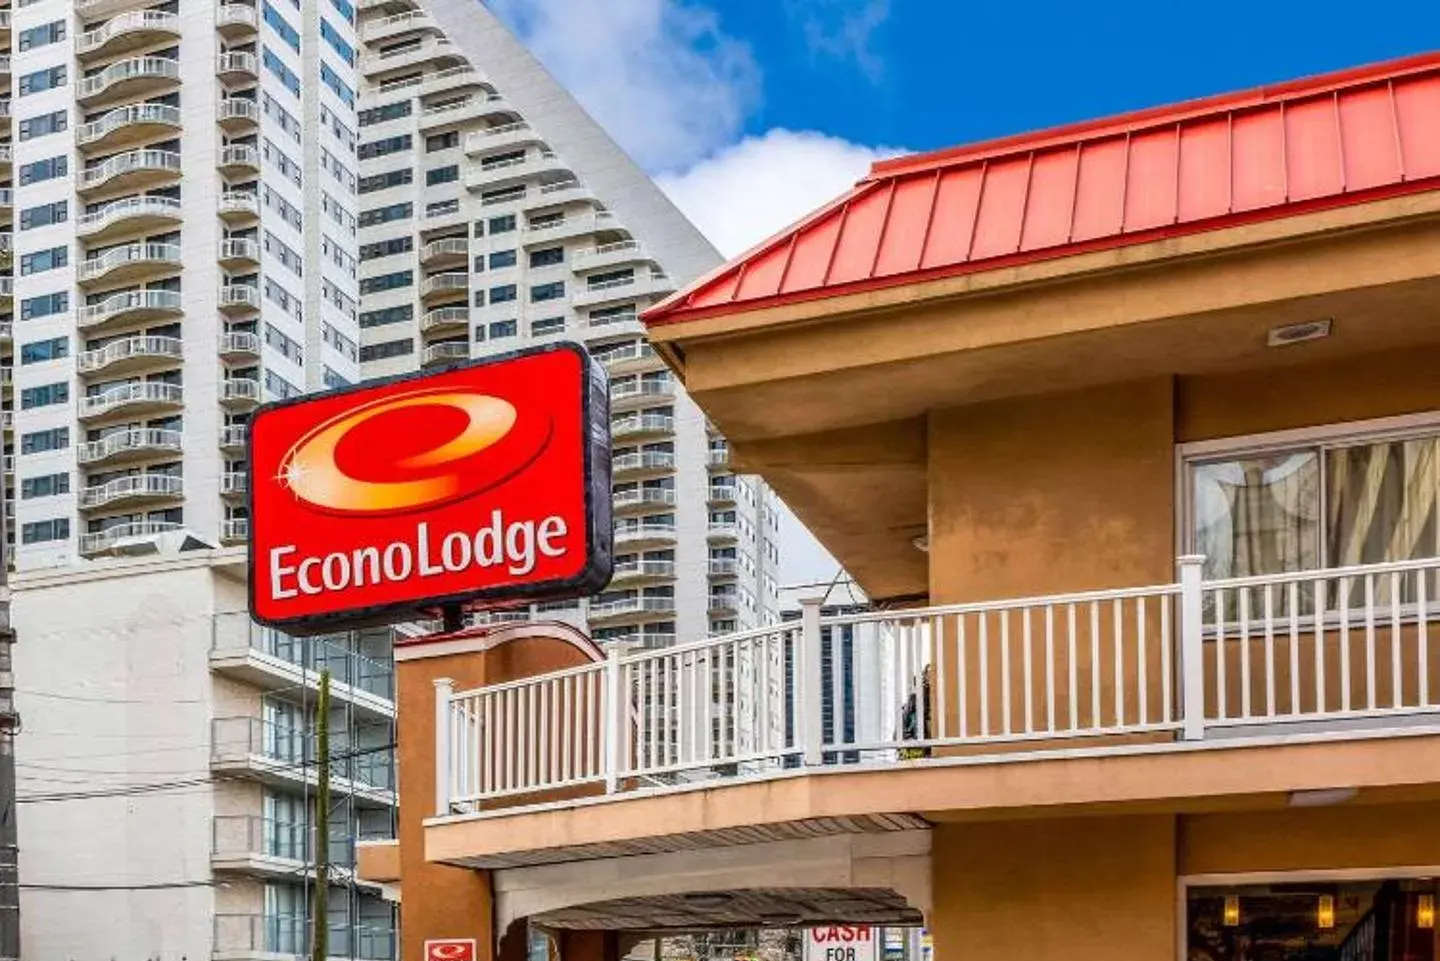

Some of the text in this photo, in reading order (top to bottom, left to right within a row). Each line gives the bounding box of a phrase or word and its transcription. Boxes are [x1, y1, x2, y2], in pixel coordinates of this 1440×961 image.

[270, 509, 567, 600] EconoLodge
[812, 922, 870, 942] CASH
[826, 947, 855, 961] FOR
